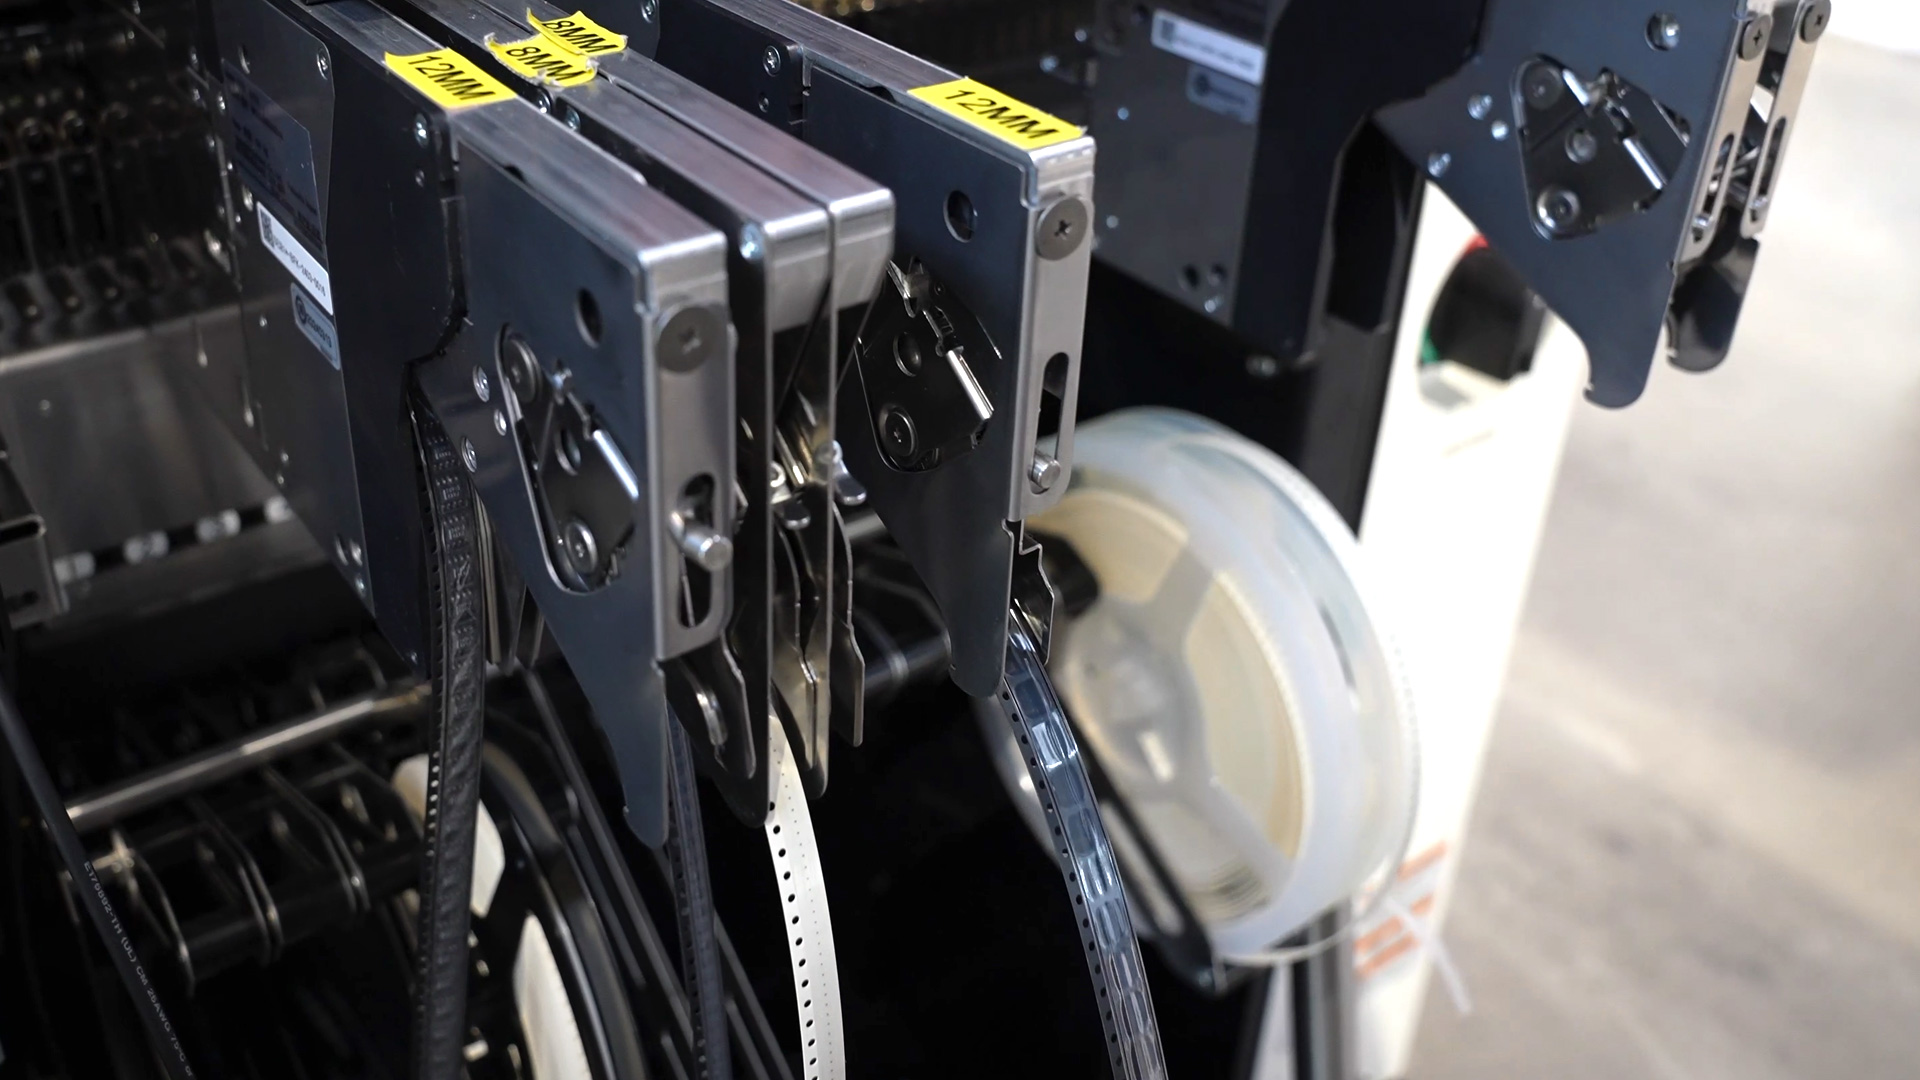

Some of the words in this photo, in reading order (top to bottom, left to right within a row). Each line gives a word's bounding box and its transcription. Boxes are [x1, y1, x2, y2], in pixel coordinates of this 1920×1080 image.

[542, 20, 618, 53] 8MM
[408, 55, 496, 101] 12MM
[506, 46, 584, 81] 8MM
[945, 89, 1059, 139] 12MM
[120, 936, 138, 962] (UL)
